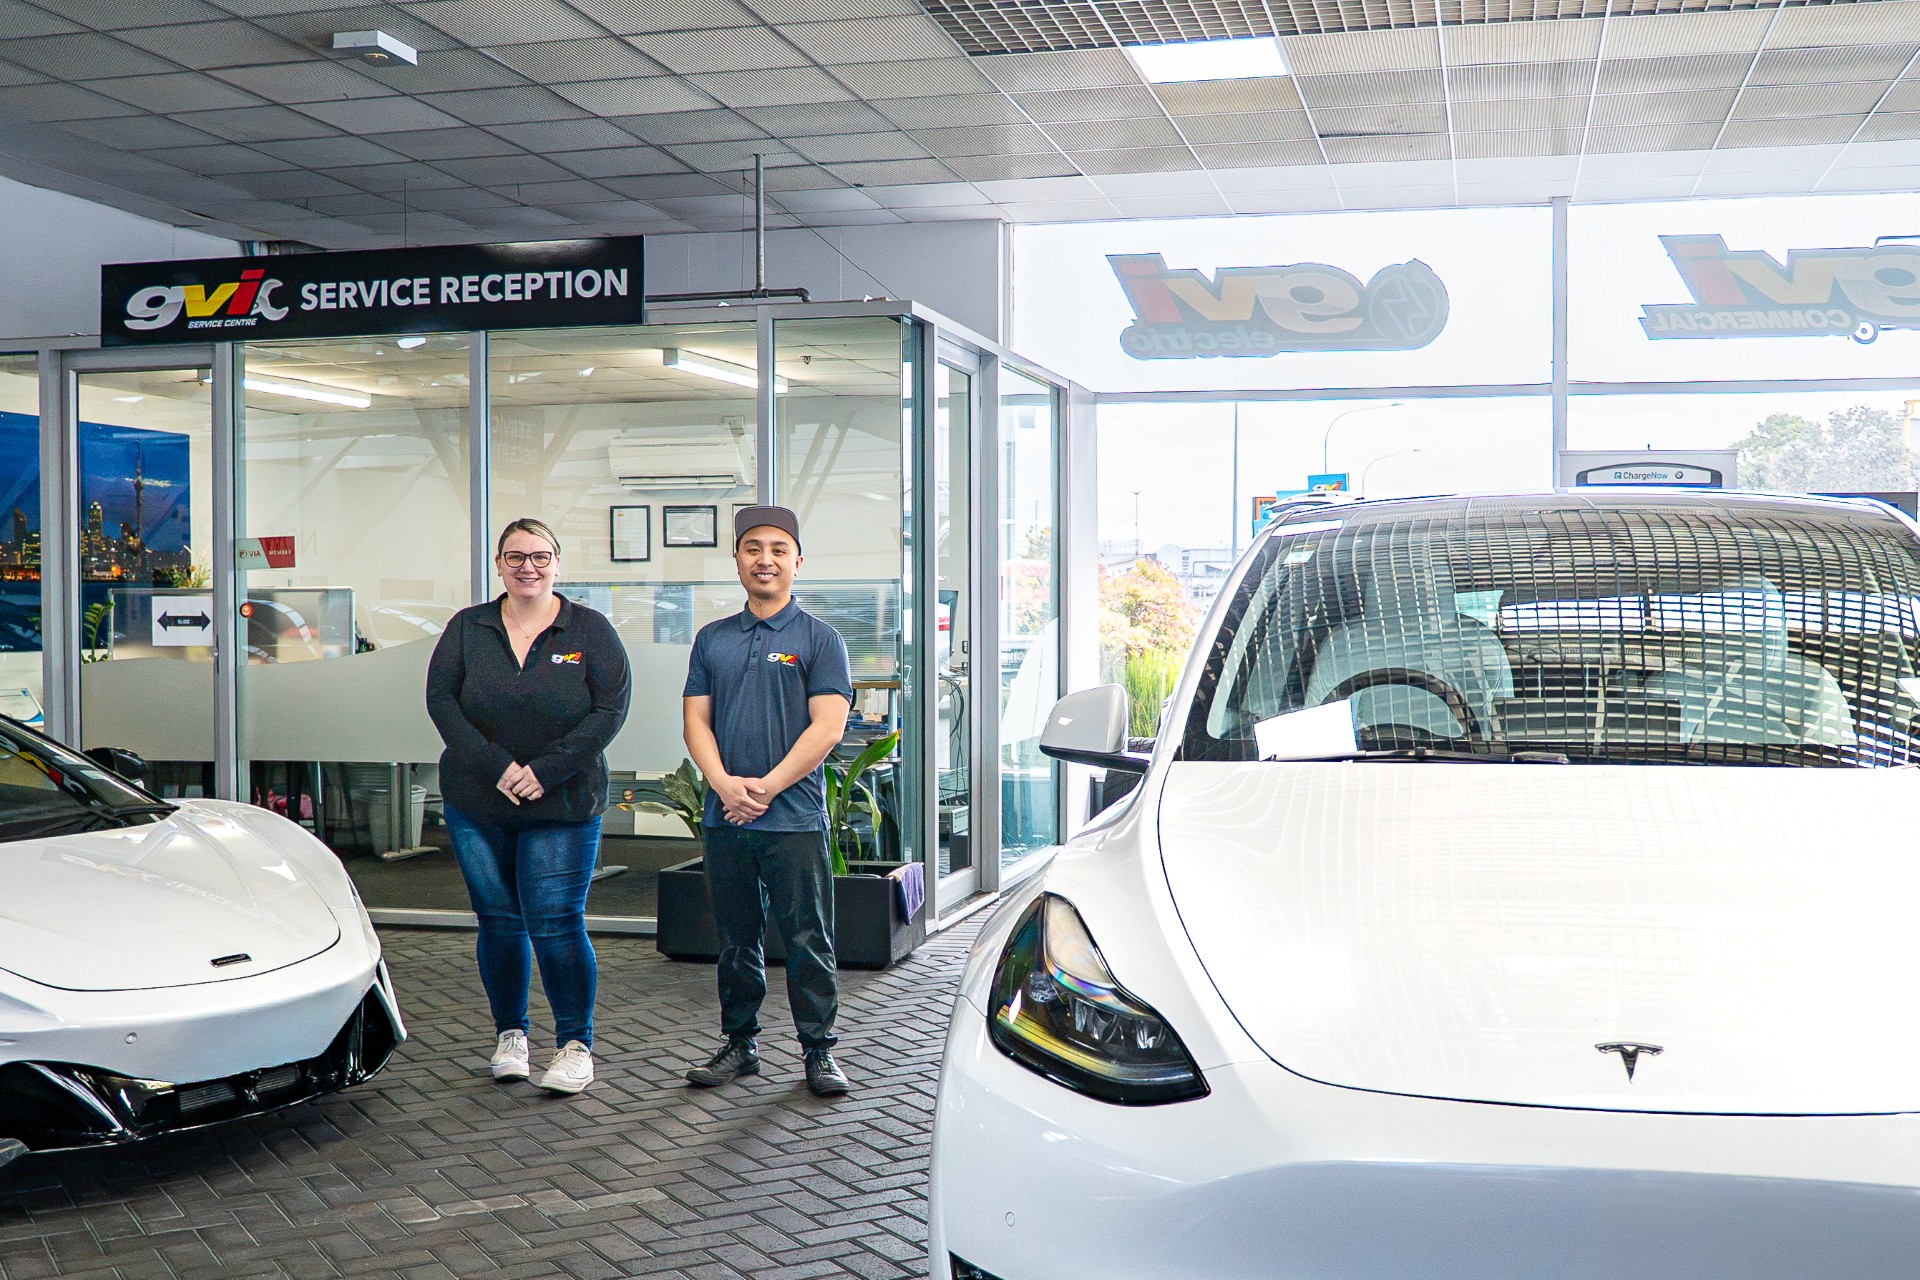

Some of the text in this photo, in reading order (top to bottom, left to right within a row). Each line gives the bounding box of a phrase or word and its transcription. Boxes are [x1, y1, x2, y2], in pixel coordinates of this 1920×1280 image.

[300, 268, 628, 311] SERVICE RECEPTION
[188, 318, 258, 329] SERVICE CENTRE
[1623, 471, 1668, 481] ChargeNow
[249, 550, 262, 558] VIA
